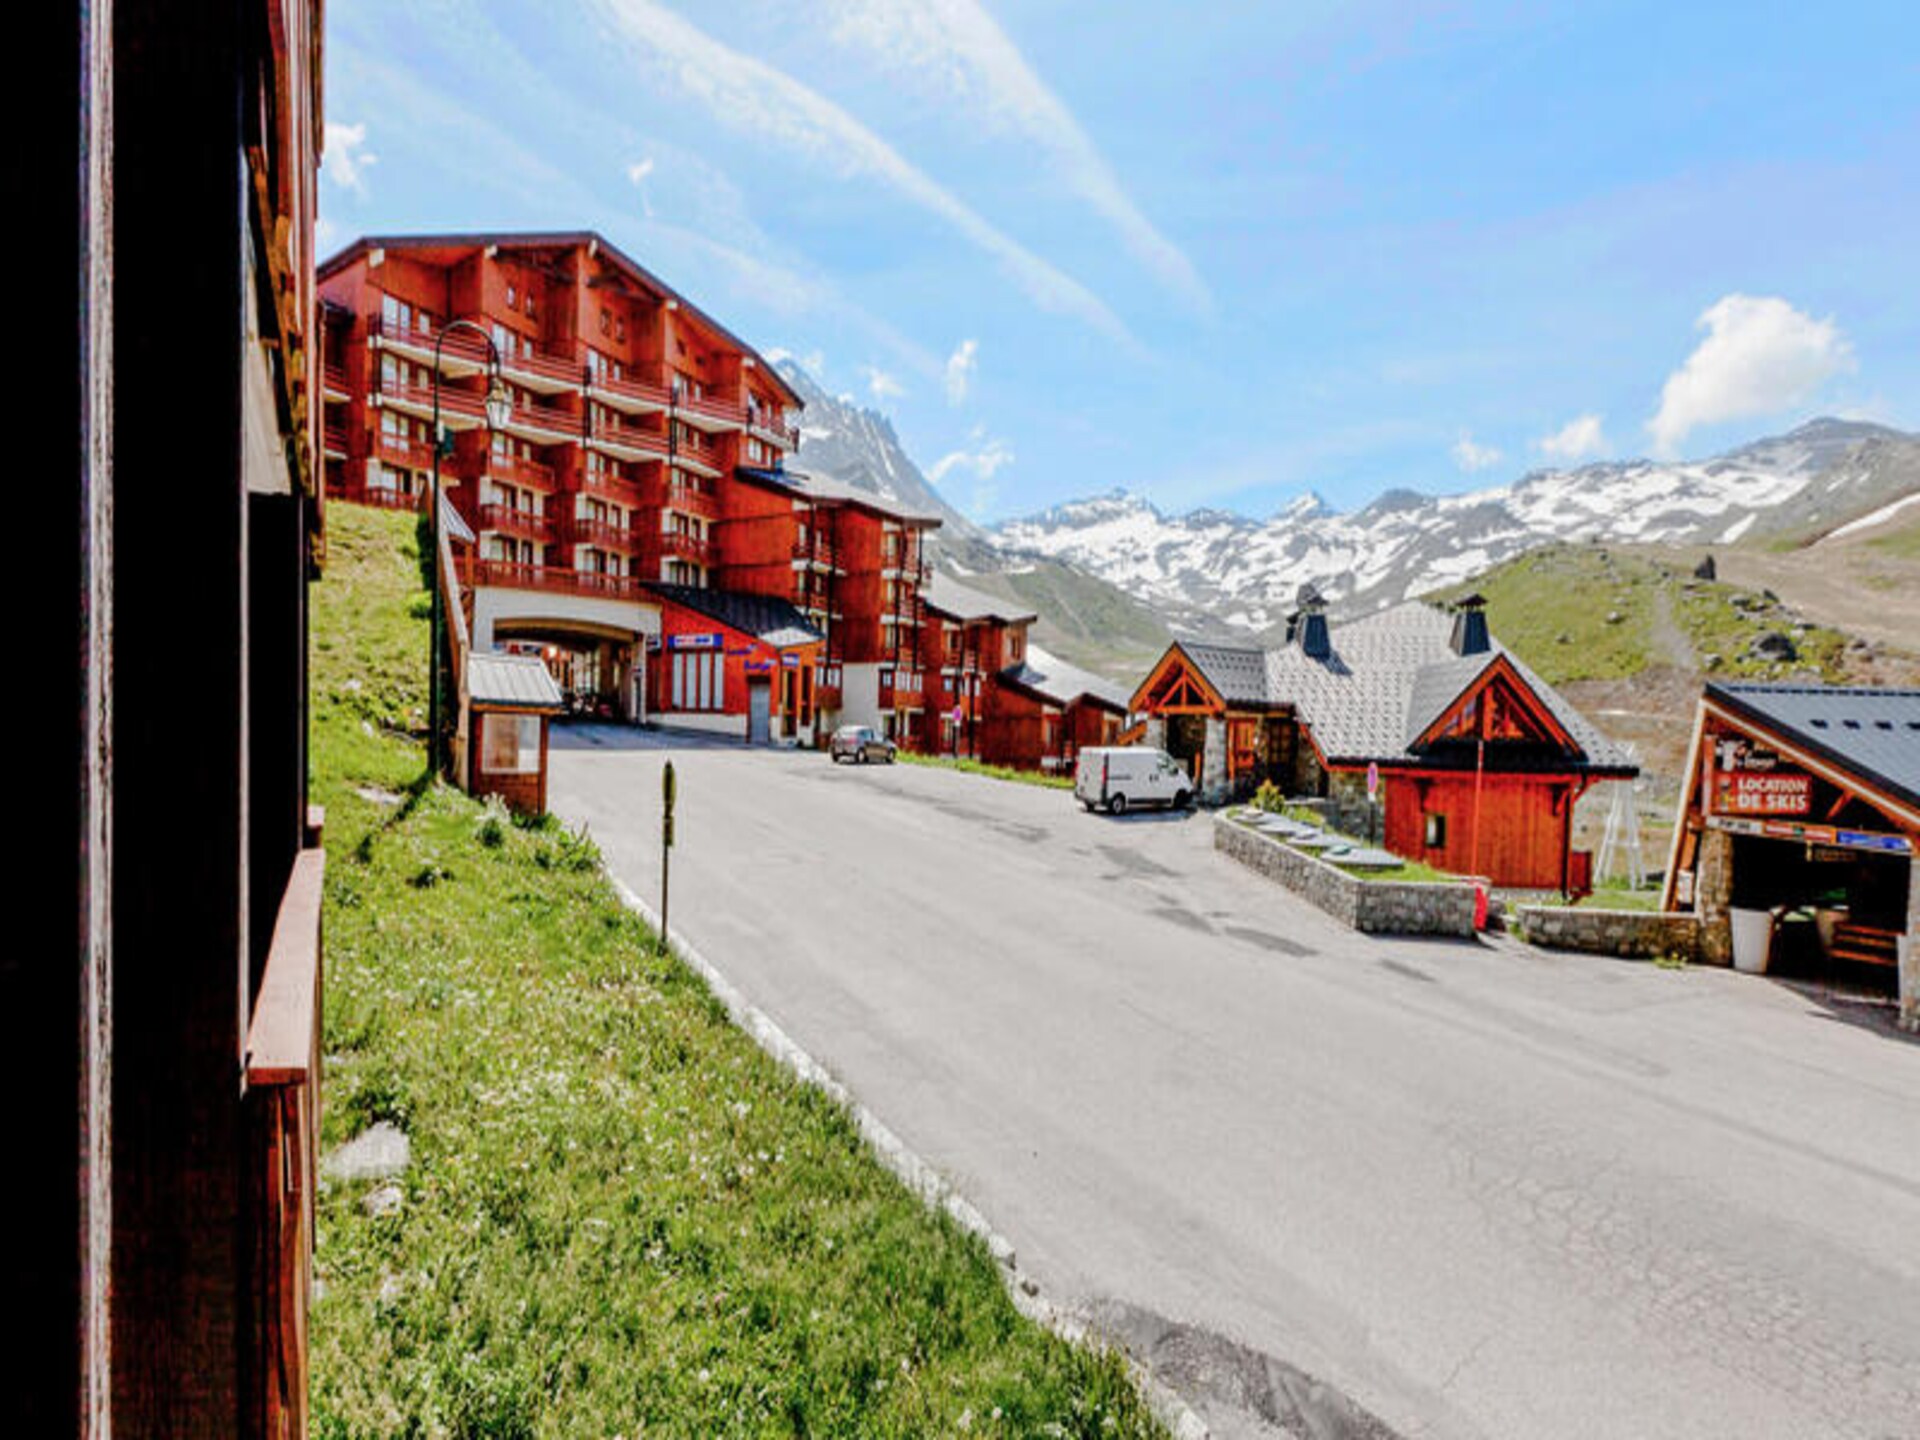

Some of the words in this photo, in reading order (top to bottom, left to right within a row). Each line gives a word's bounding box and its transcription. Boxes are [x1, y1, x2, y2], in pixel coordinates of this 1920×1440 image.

[1737, 777, 1808, 793] LOCATION
[1737, 794, 1761, 809] DE
[1767, 795, 1806, 811] SKIS
